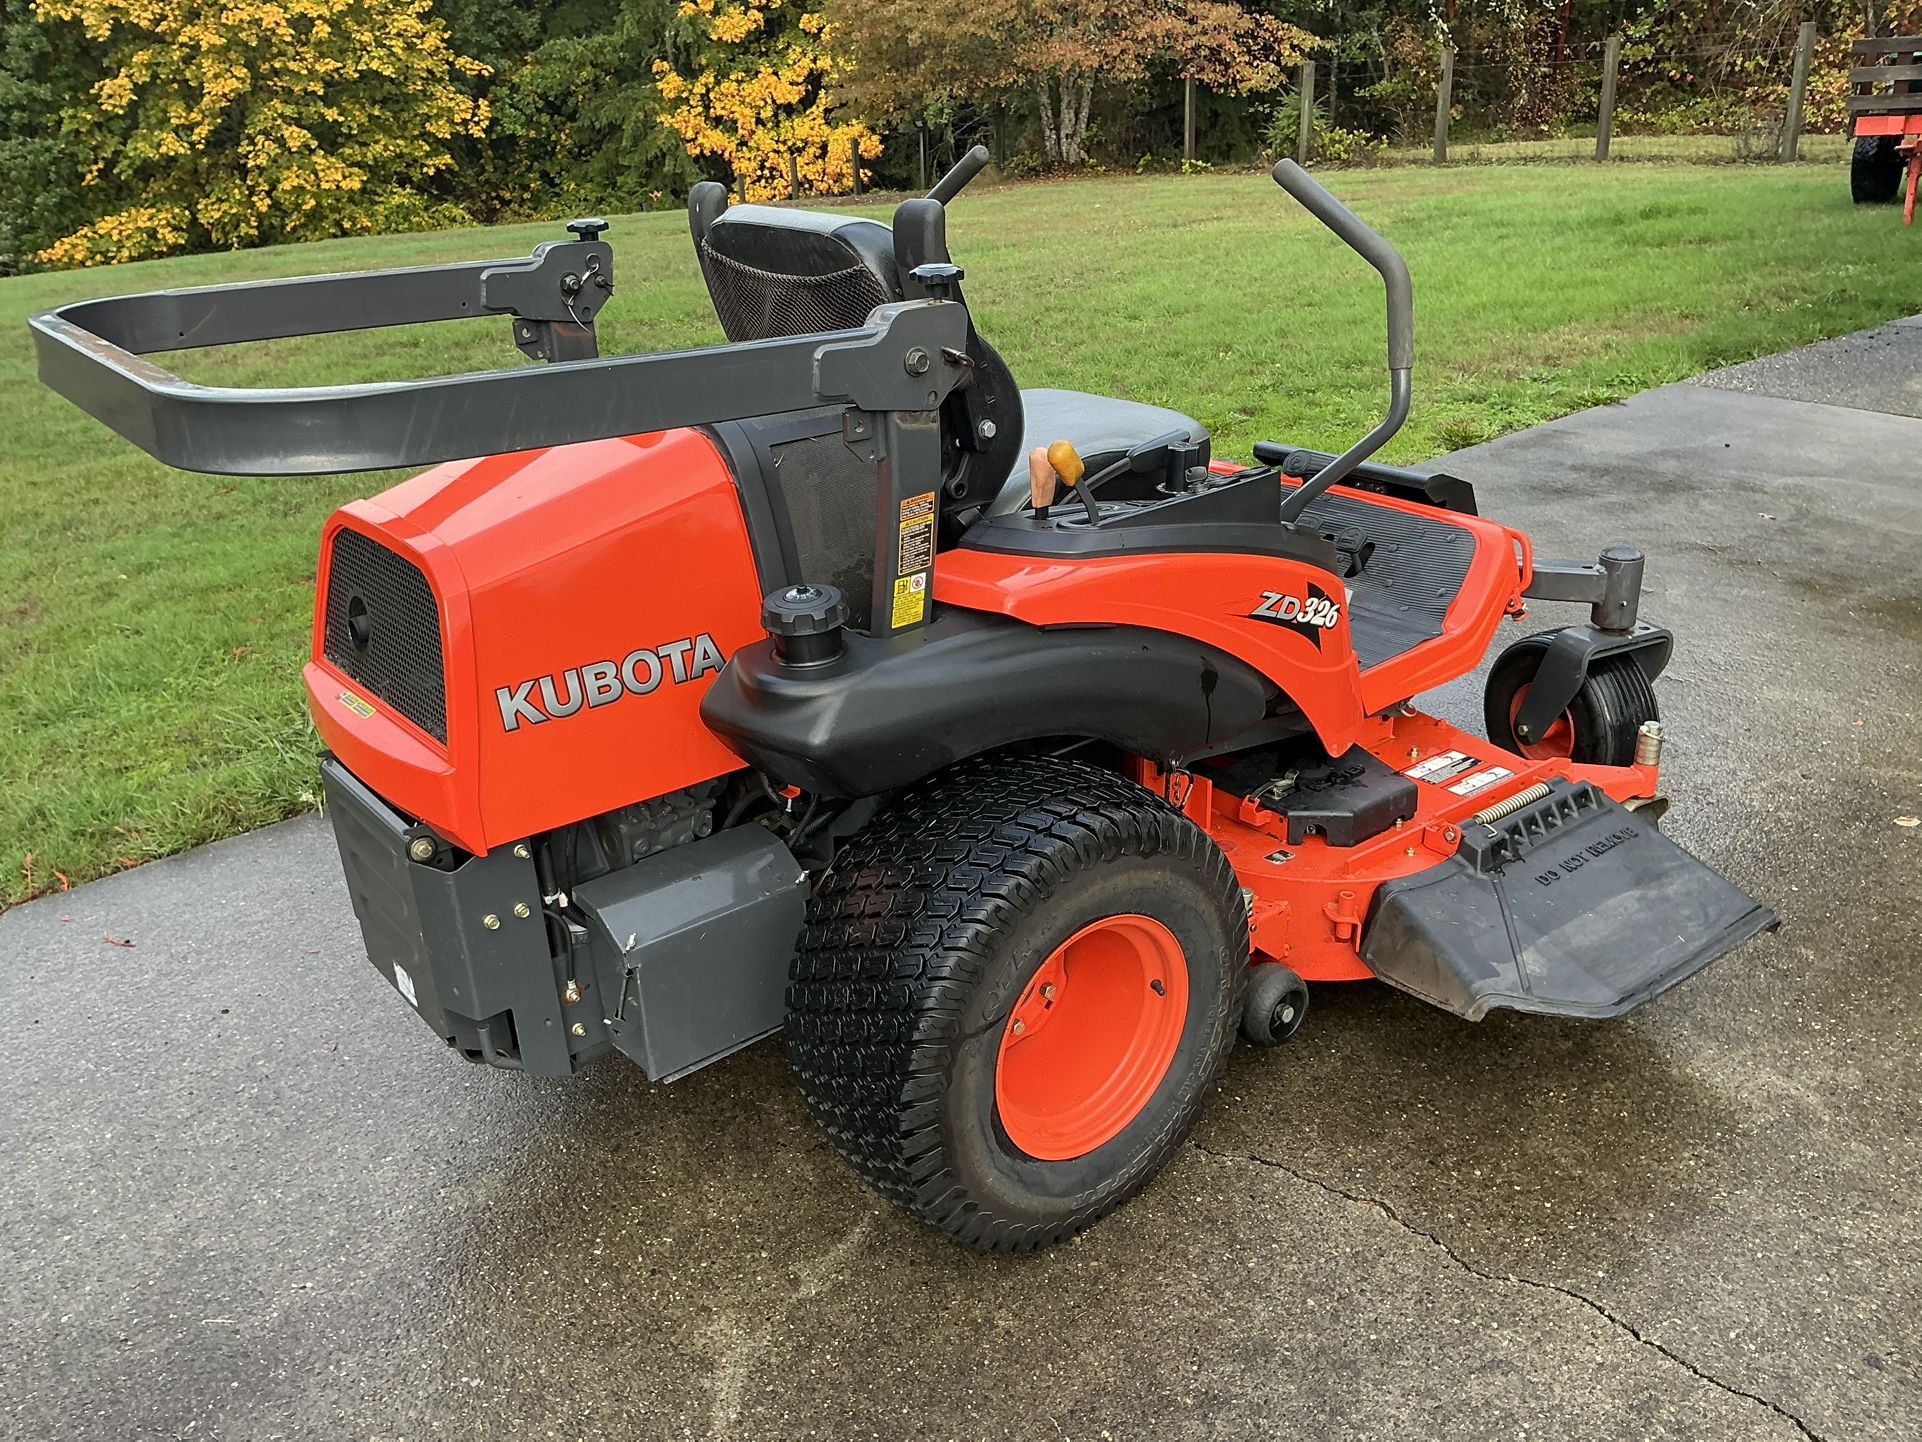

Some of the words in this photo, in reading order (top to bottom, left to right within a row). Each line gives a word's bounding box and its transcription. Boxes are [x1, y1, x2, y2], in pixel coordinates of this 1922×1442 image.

[1249, 590, 1341, 628] ZD326
[495, 632, 727, 732] KUBOTA
[1535, 870, 1560, 886] DO
[1559, 851, 1589, 873] NOT
[1585, 826, 1639, 858] REMOVE
